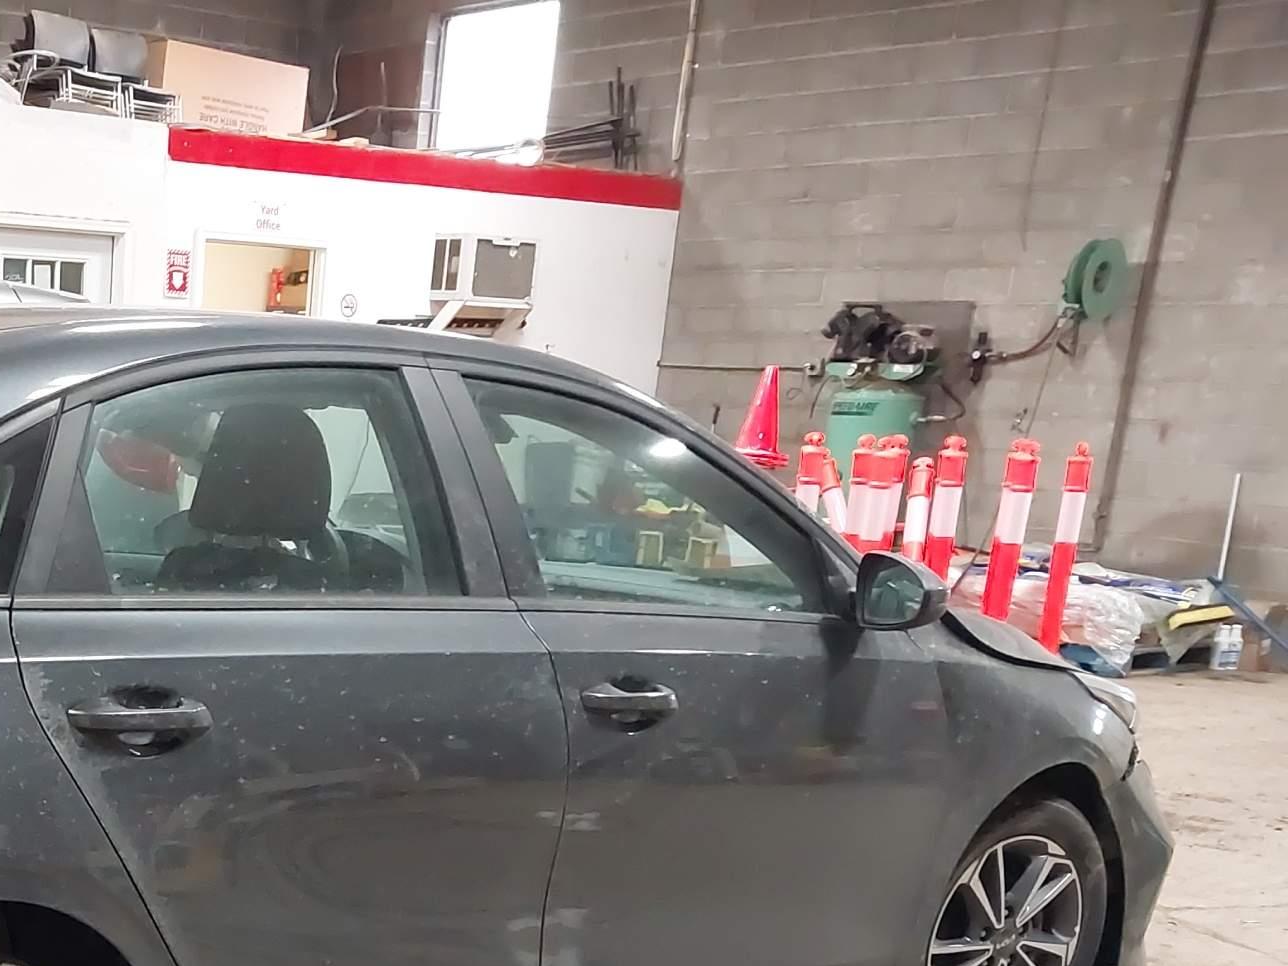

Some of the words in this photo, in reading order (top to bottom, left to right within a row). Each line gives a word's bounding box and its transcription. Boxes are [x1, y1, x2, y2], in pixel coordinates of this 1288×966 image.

[199, 112, 219, 124] CARE
[220, 115, 238, 127] WITH
[261, 205, 279, 216] Yard
[256, 219, 281, 231] Office
[170, 254, 189, 267] FIRE
